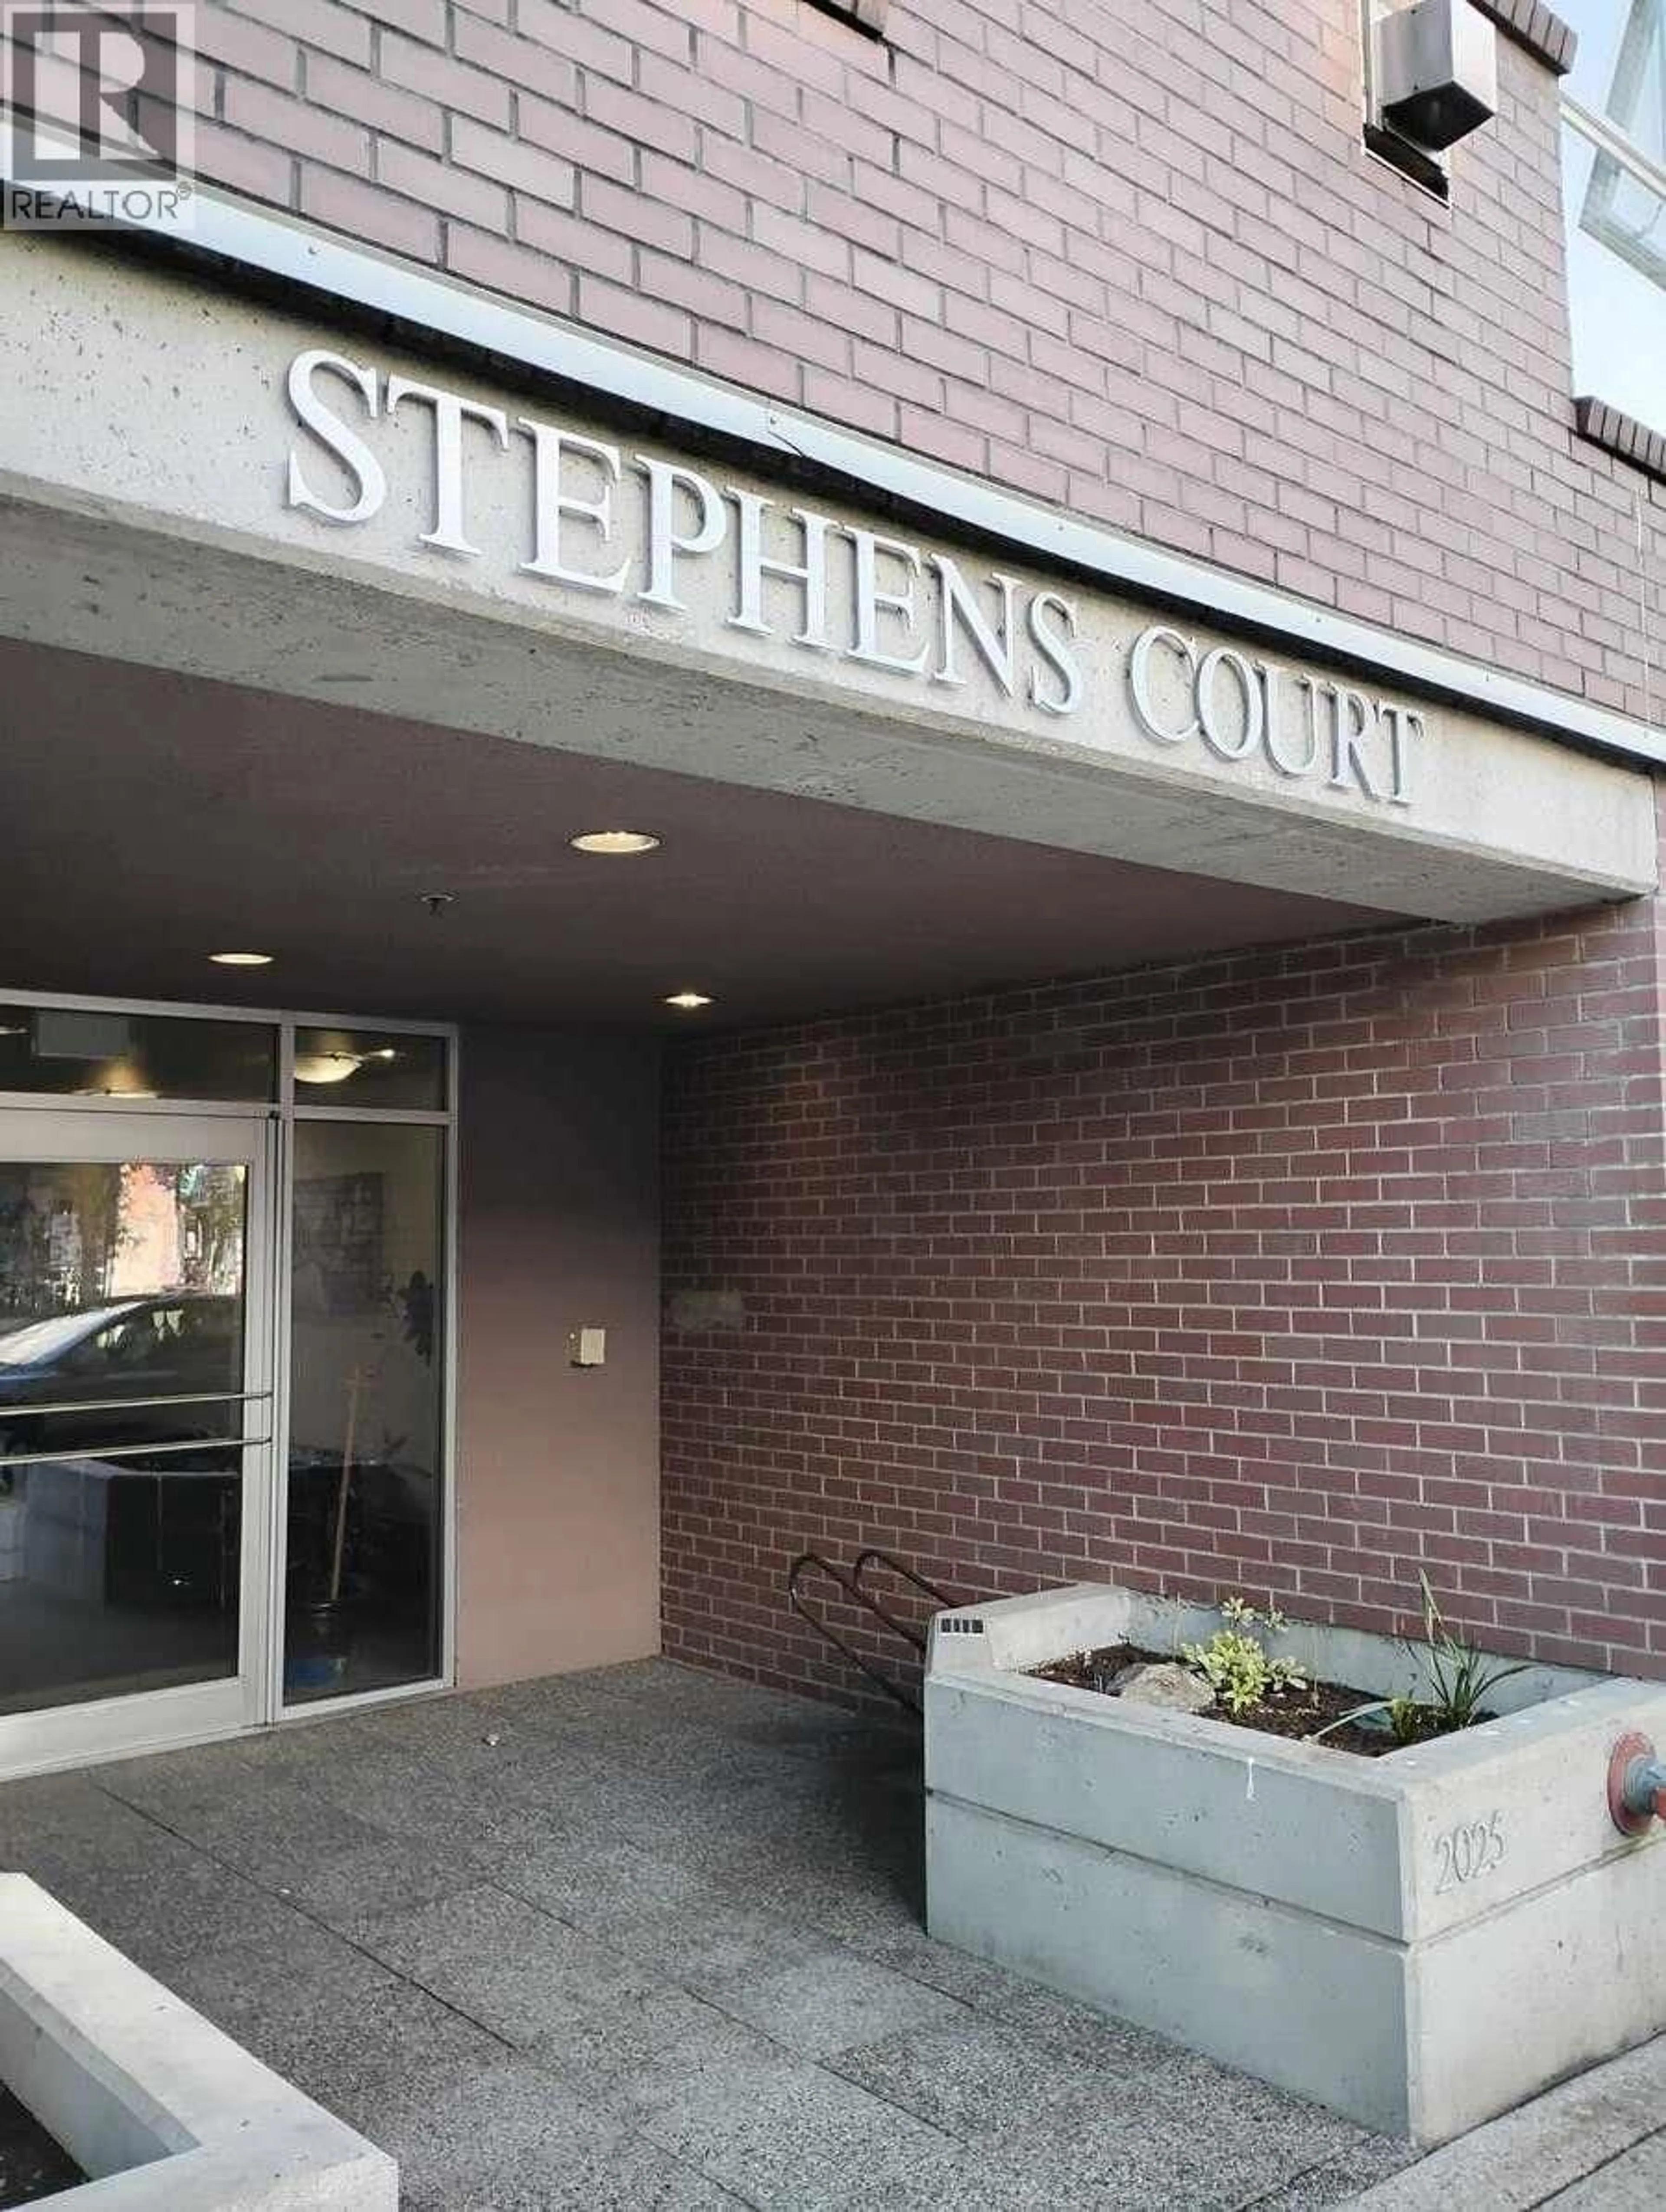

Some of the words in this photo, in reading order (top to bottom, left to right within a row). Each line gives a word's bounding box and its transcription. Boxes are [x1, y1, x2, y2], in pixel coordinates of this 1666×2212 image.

[285, 348, 1086, 716] STEPHENS
[1130, 625, 1425, 804] COURT
[1434, 1809, 1504, 1895] 2025
